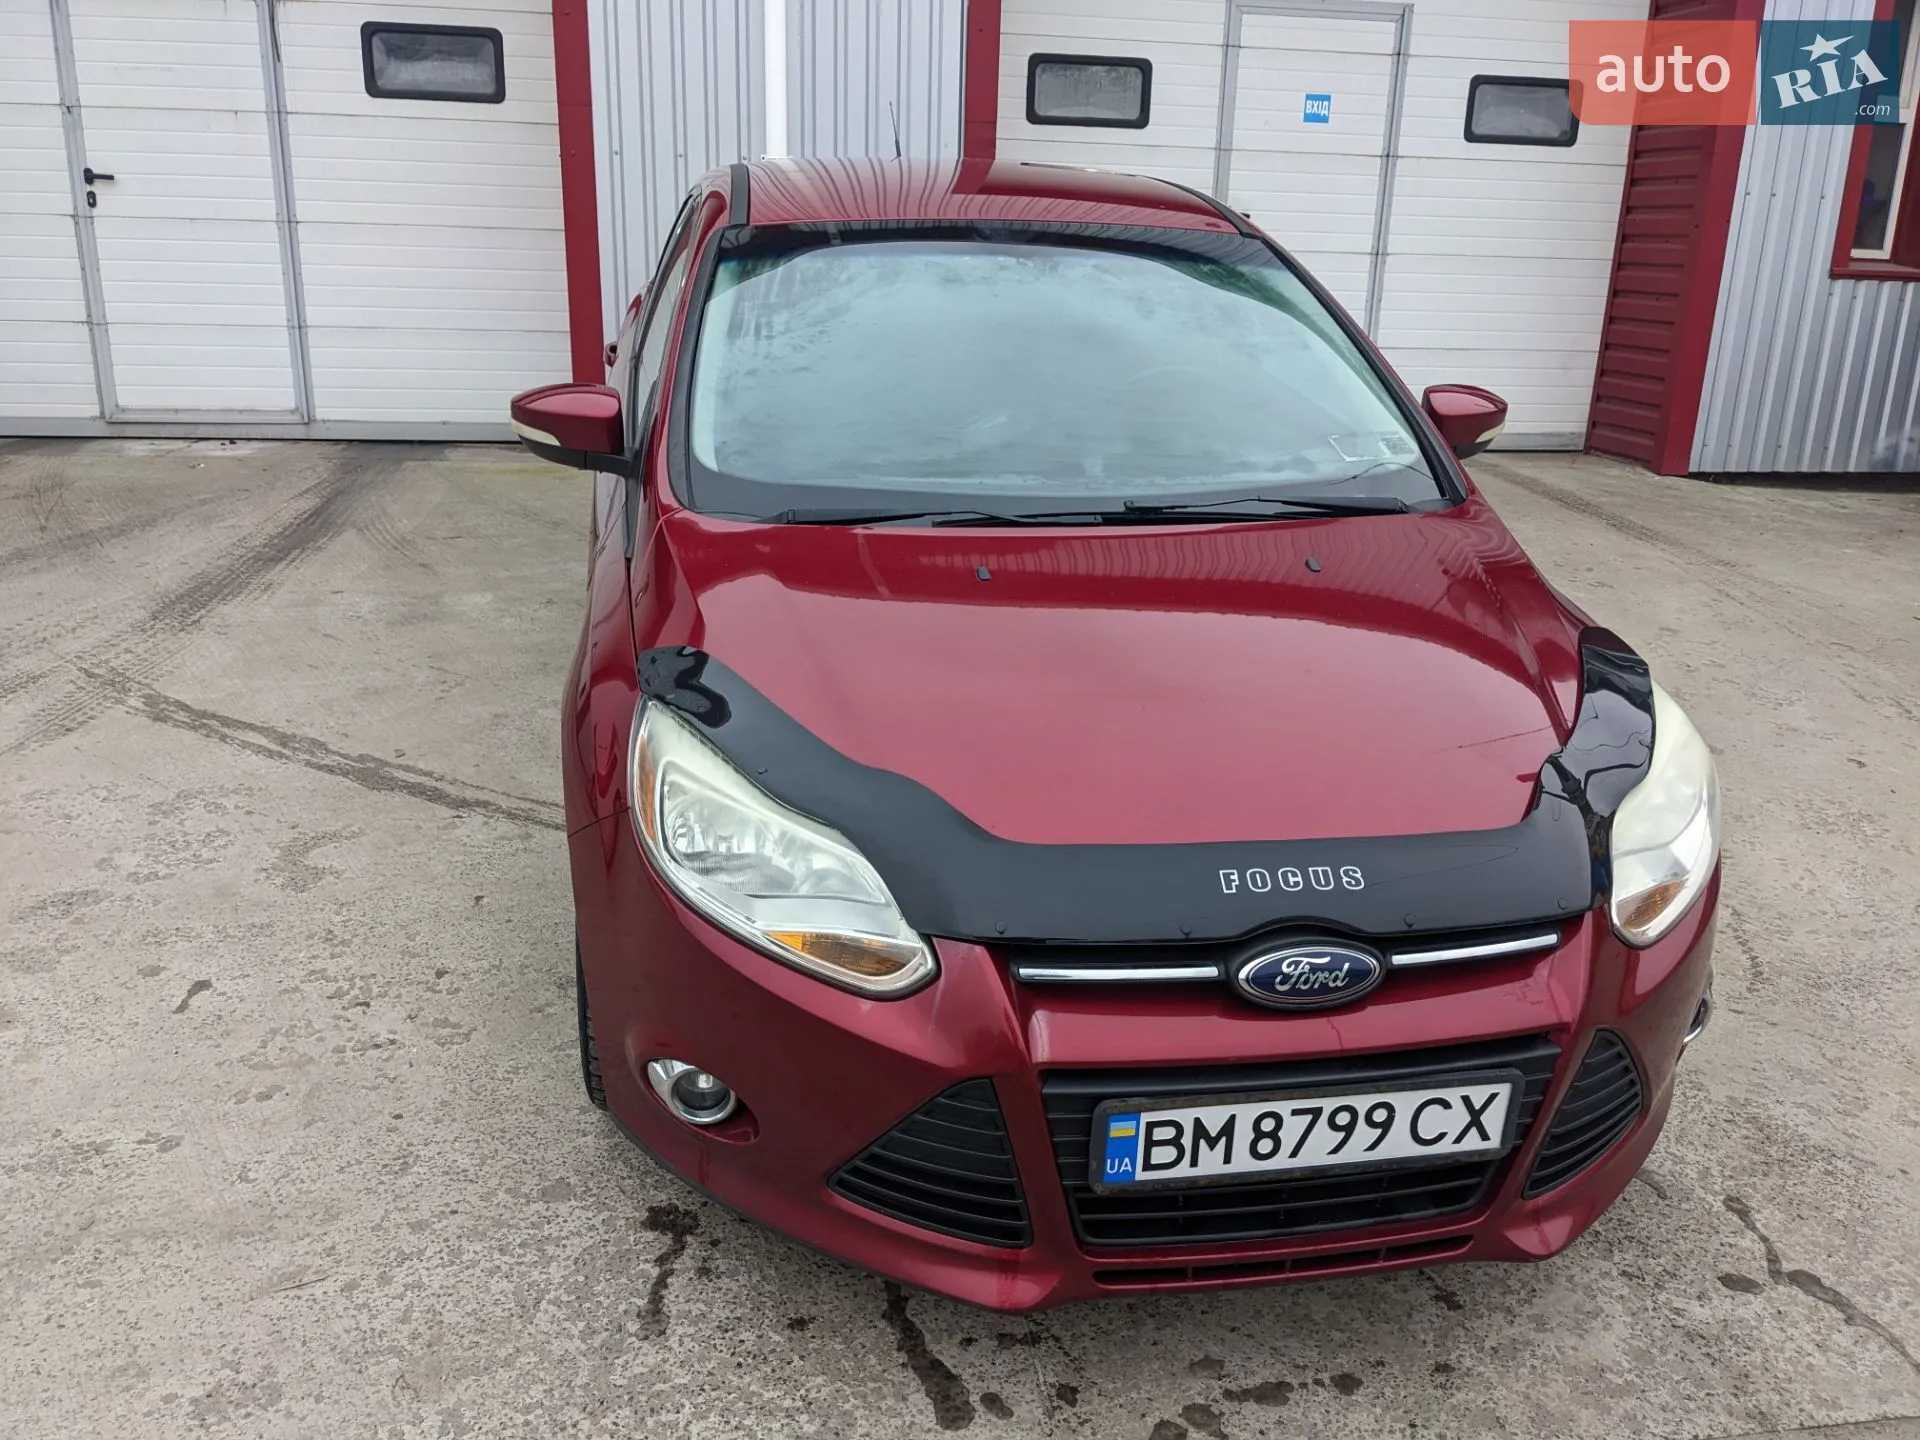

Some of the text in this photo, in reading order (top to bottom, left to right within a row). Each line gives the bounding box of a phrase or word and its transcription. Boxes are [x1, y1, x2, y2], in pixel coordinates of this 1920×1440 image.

[1305, 100, 1329, 117] ВХІД
[1219, 866, 1365, 894] FOCUS
[1274, 956, 1350, 992] Ford
[1141, 1091, 1500, 1173] BM 8799 CX
[1106, 1158, 1132, 1174] UA
